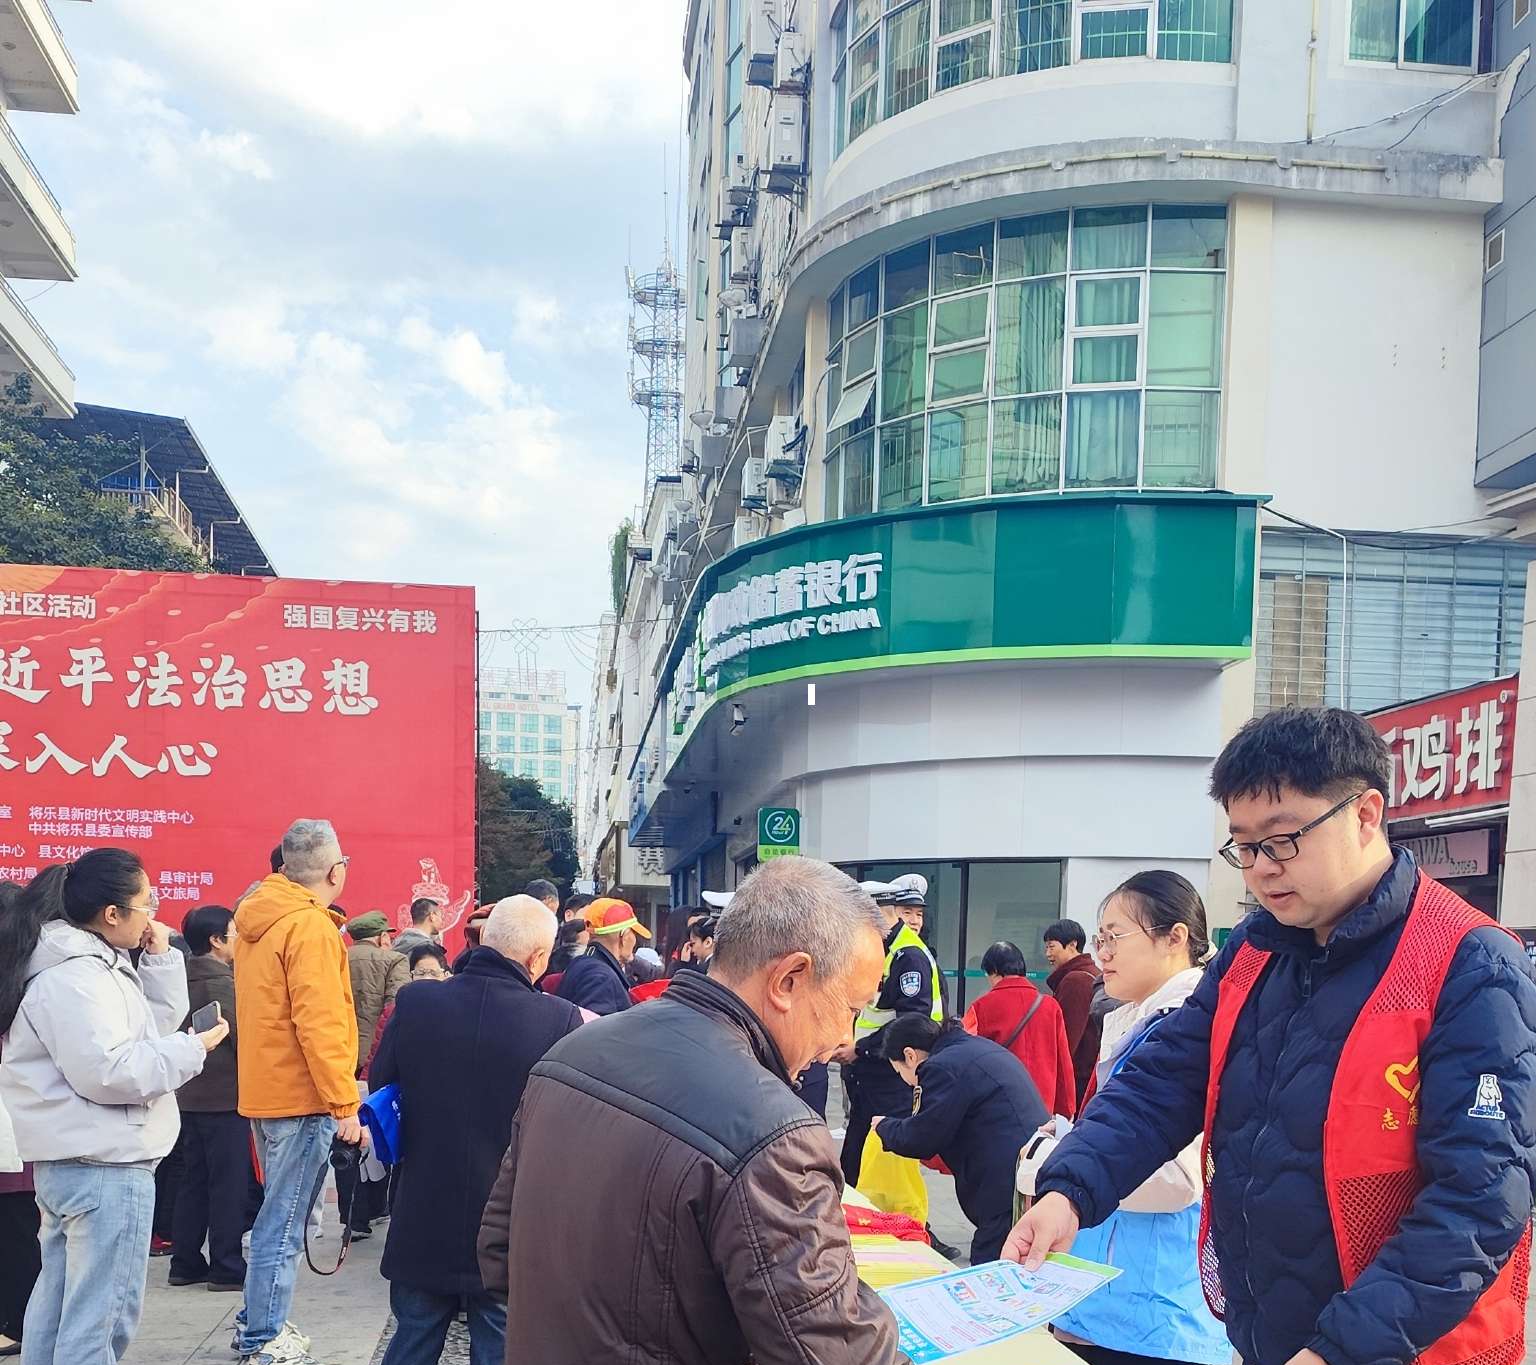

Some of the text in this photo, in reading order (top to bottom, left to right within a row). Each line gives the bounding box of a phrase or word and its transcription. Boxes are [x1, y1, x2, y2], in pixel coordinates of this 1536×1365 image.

[0, 593, 437, 635] 社区活动 强国复兴有我
[789, 616, 817, 640] OF
[816, 607, 881, 636] CHINA
[29, 806, 194, 825] 将乐县新时代文明实践中心
[773, 816, 791, 830] 24
[28, 822, 153, 839] 中共将乐县委宣传部
[159, 871, 214, 886] 县审计局
